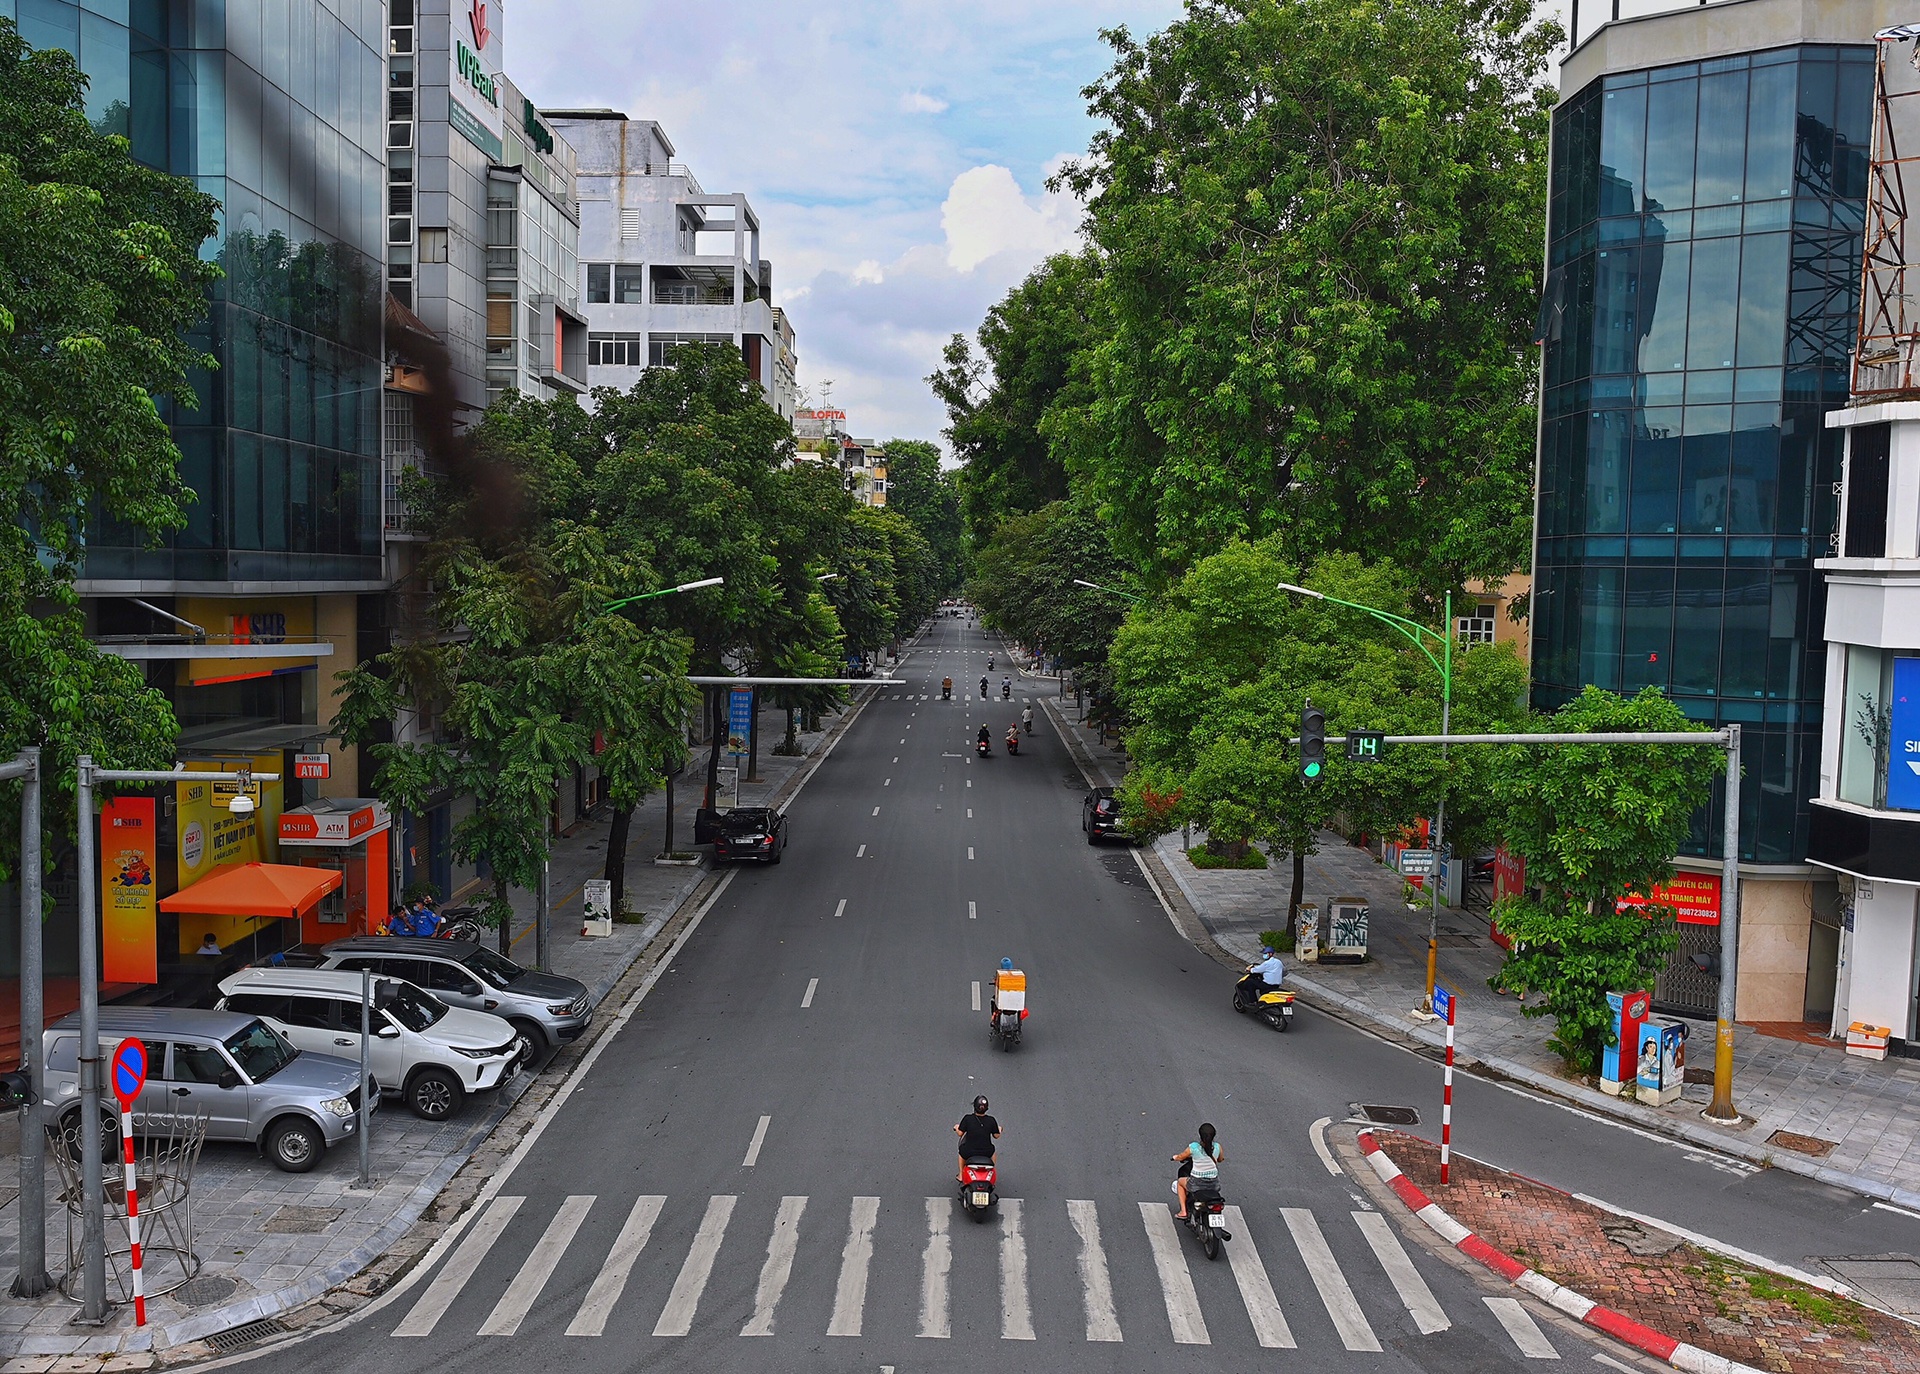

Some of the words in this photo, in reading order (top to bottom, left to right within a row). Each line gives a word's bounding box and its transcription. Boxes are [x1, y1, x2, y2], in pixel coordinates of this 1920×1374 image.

[457, 39, 498, 108] VPBank
[811, 410, 846, 420] LOFITA
[251, 614, 286, 644] SHB
[1359, 738, 1376, 755] 14
[301, 765, 323, 777] ATM
[188, 785, 204, 800] SHB
[122, 818, 142, 827] SHB
[326, 824, 344, 832] ATM
[226, 829, 239, 845] NAM
[1671, 894, 1694, 903] THANG
[1696, 895, 1712, 905] MÁY
